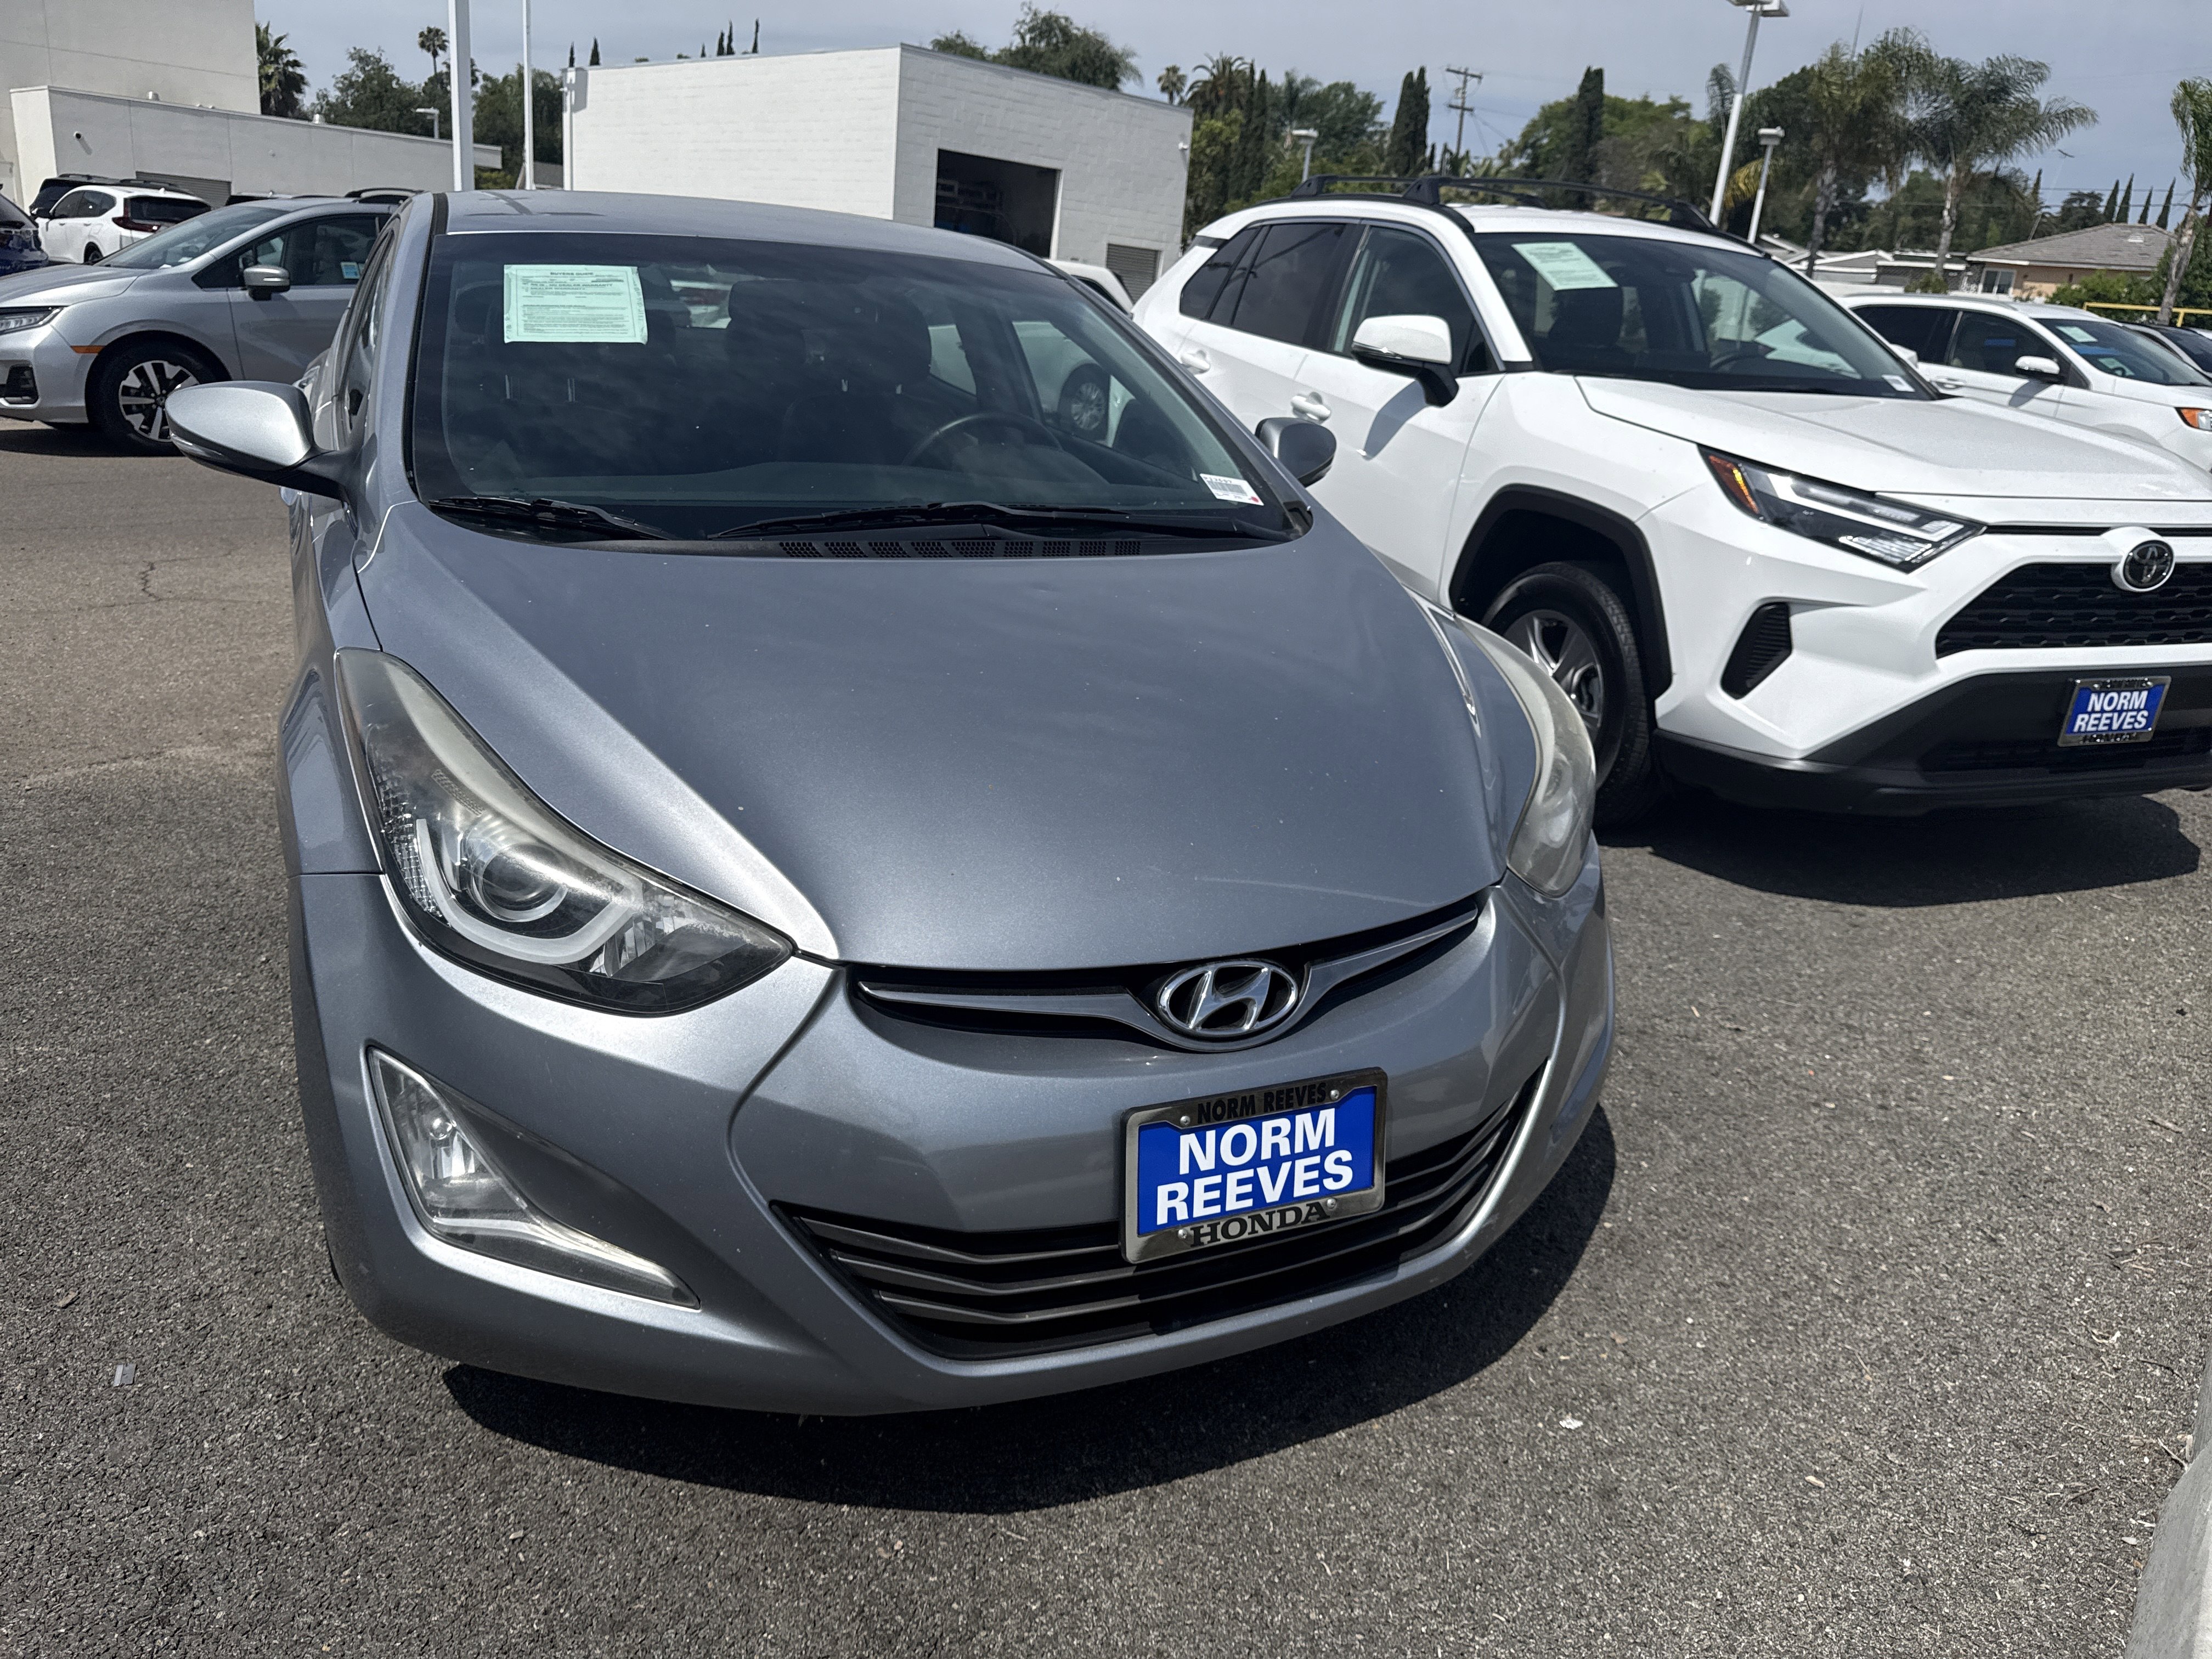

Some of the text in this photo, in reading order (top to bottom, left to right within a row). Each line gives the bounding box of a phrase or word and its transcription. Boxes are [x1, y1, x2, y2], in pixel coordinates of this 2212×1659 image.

[2073, 710, 2148, 732] REEVES
[2087, 690, 2148, 712] NORM
[1197, 1082, 1327, 1124] NORM REEVES
[1179, 1108, 1335, 1175] NORM
[1156, 1149, 1353, 1226] REEVES
[1190, 1201, 1330, 1248] HONDA
